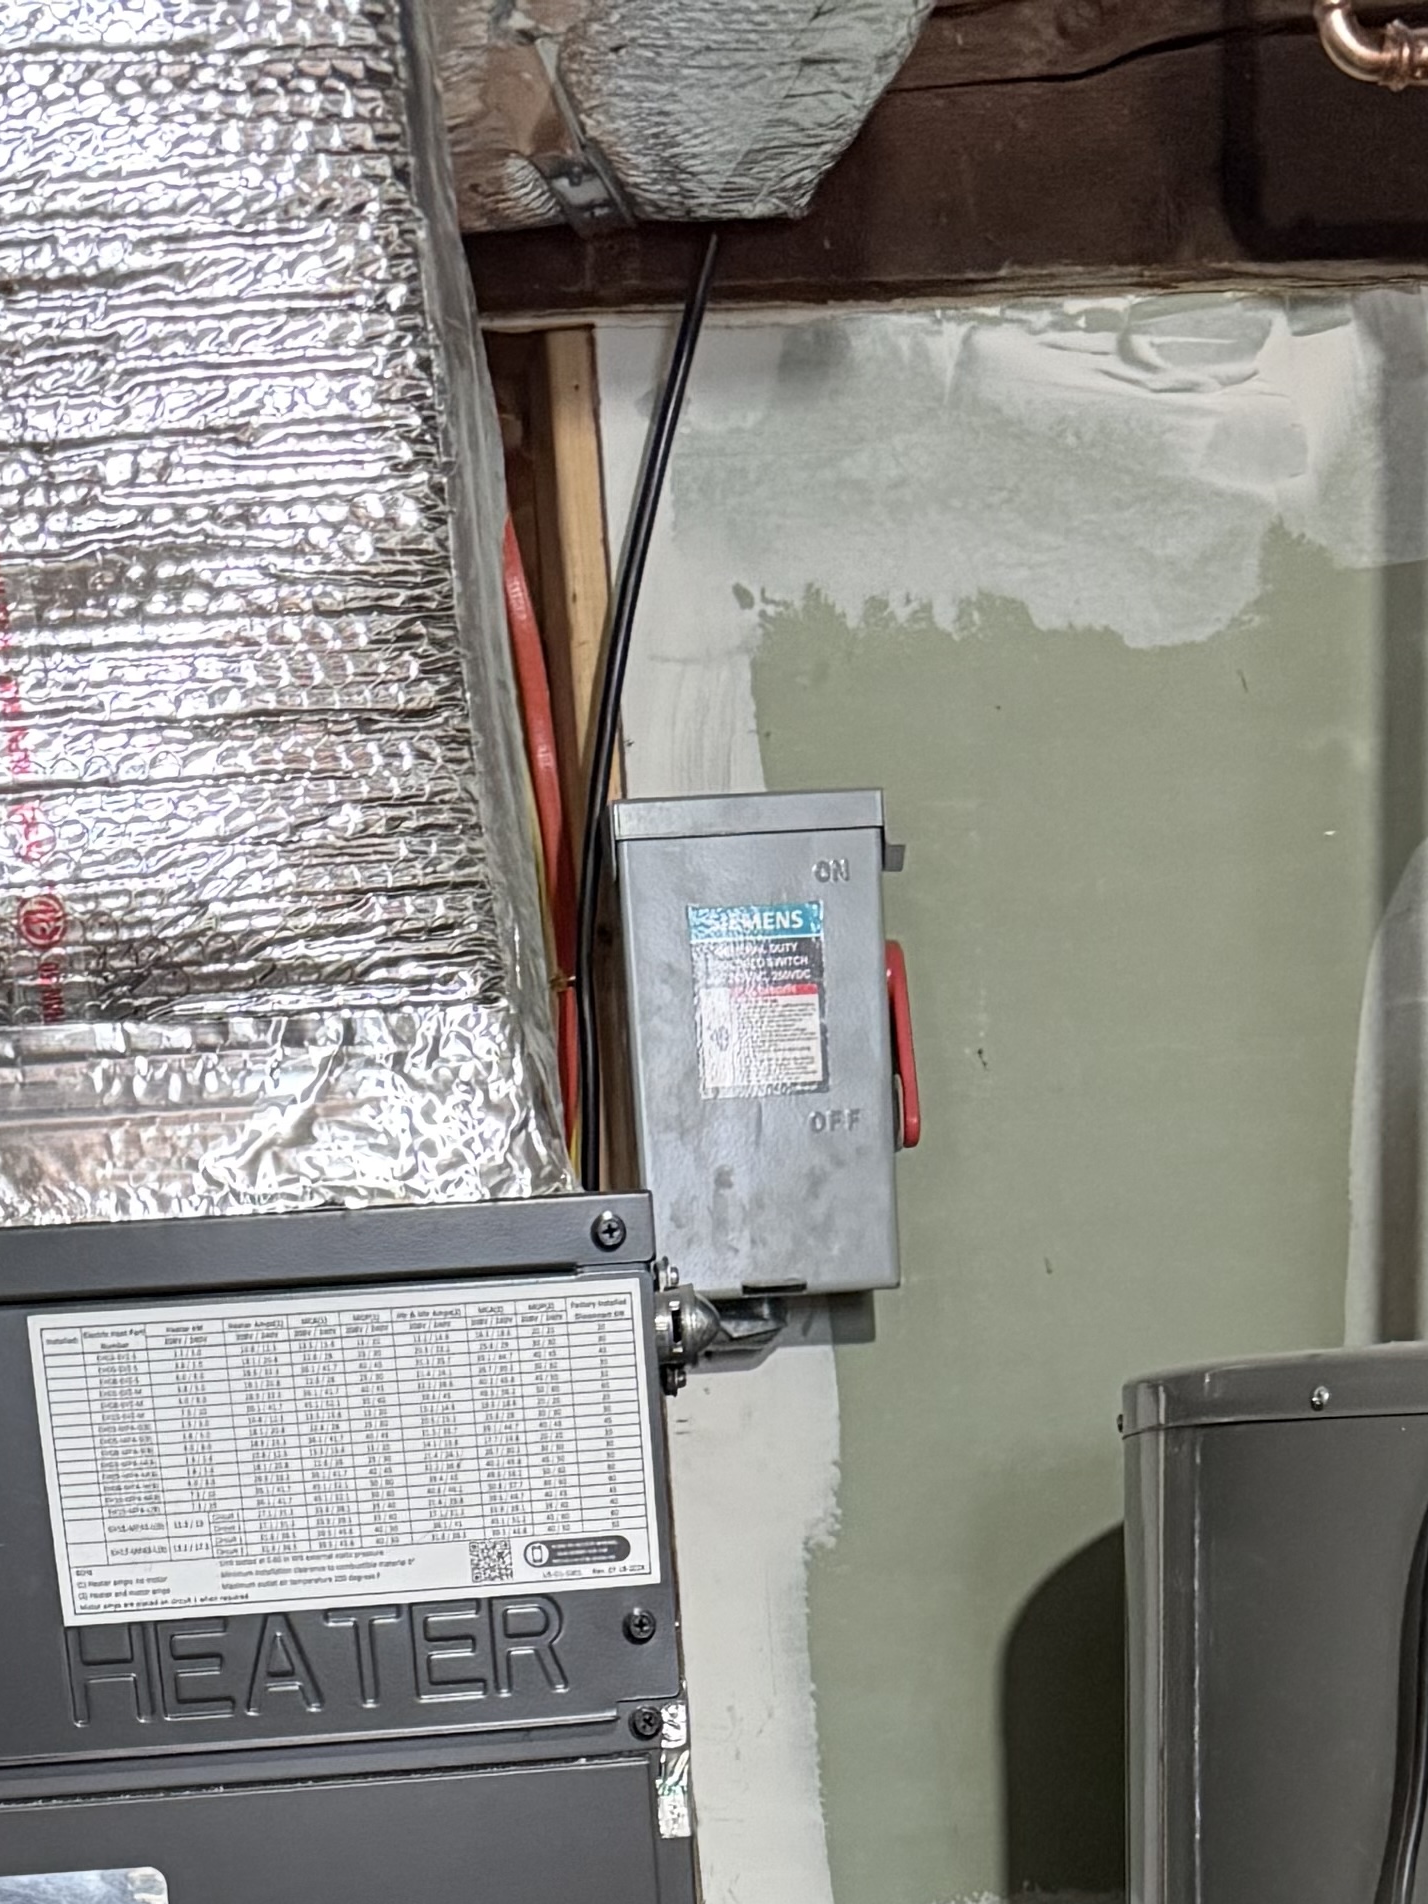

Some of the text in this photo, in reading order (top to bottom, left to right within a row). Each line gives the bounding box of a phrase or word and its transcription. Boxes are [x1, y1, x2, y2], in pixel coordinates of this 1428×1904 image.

[814, 859, 849, 883] ON
[811, 1111, 860, 1132] OFF
[66, 1594, 569, 1728] HEATER
